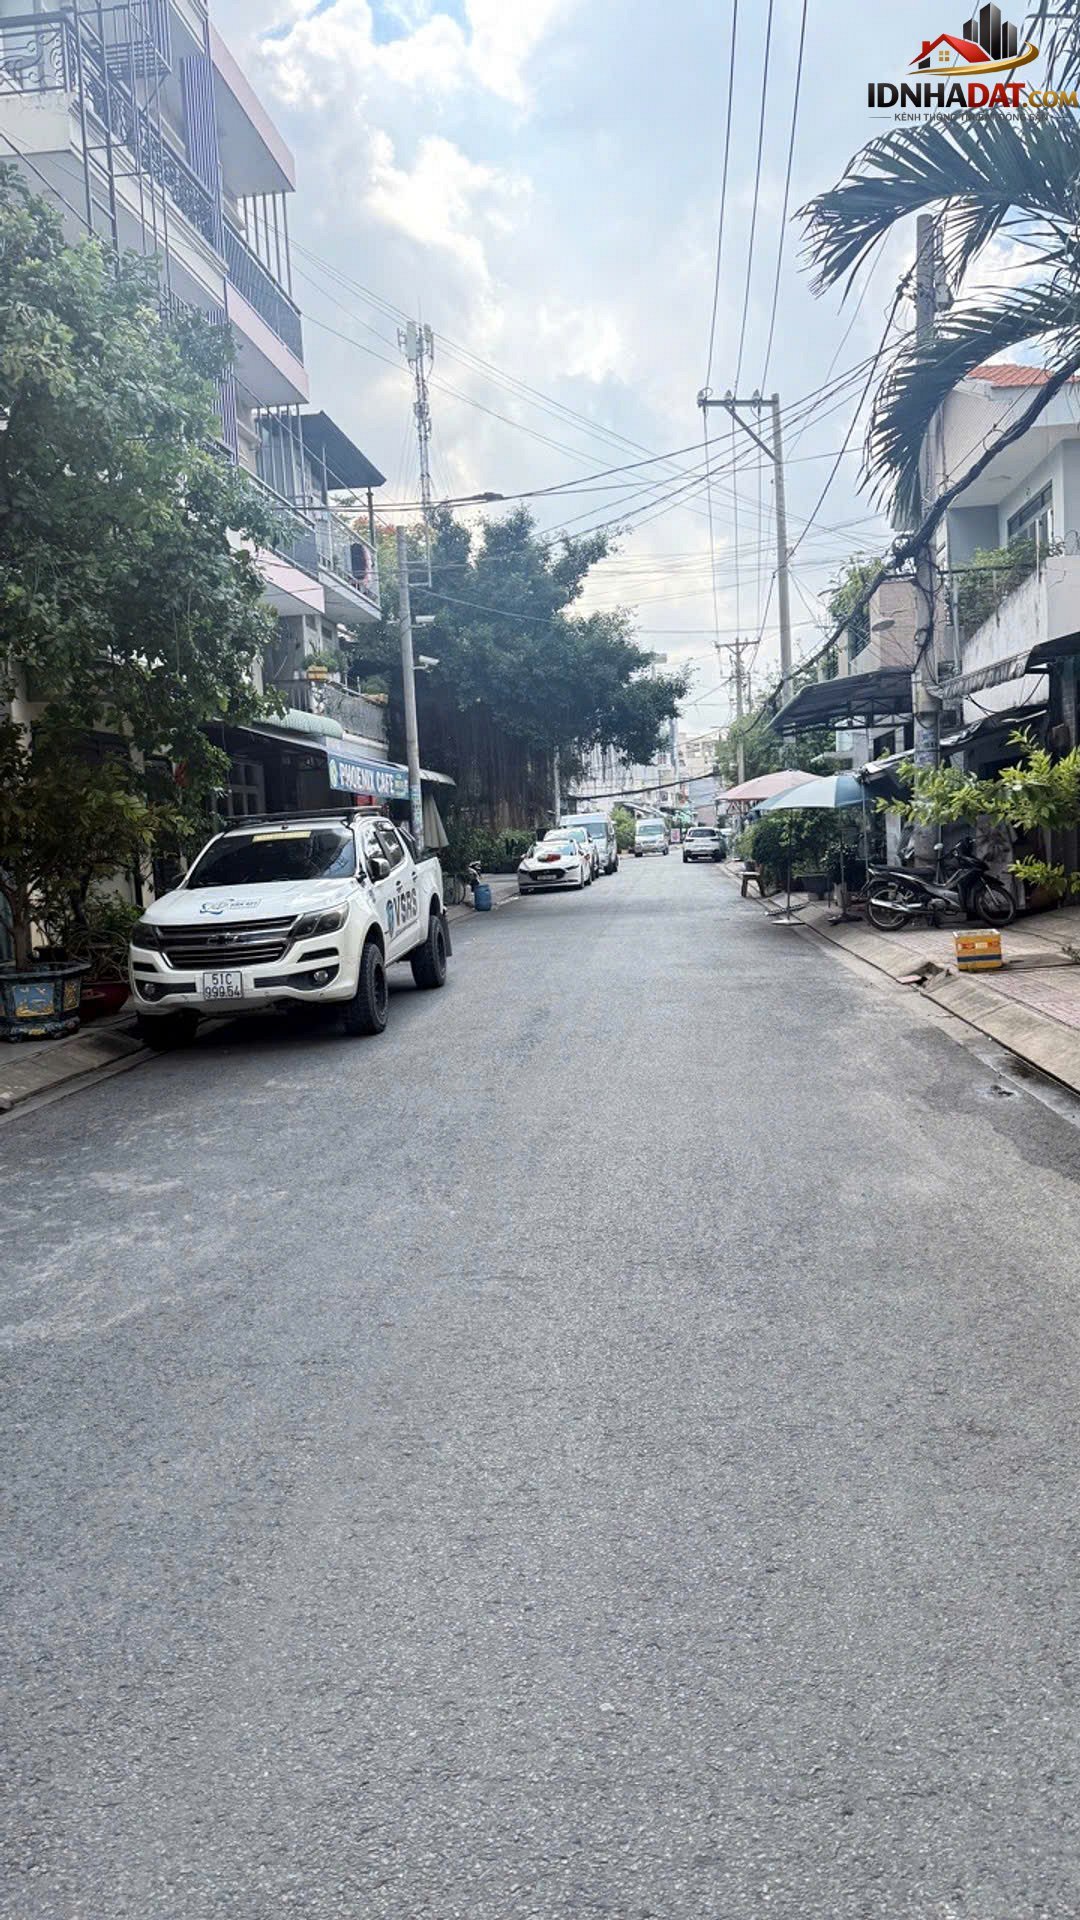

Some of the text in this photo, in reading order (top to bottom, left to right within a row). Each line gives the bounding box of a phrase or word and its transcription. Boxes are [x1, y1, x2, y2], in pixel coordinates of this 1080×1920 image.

[339, 762, 374, 791] PHOENIX
[376, 771, 394, 794] CAFE
[212, 973, 232, 985] 51C
